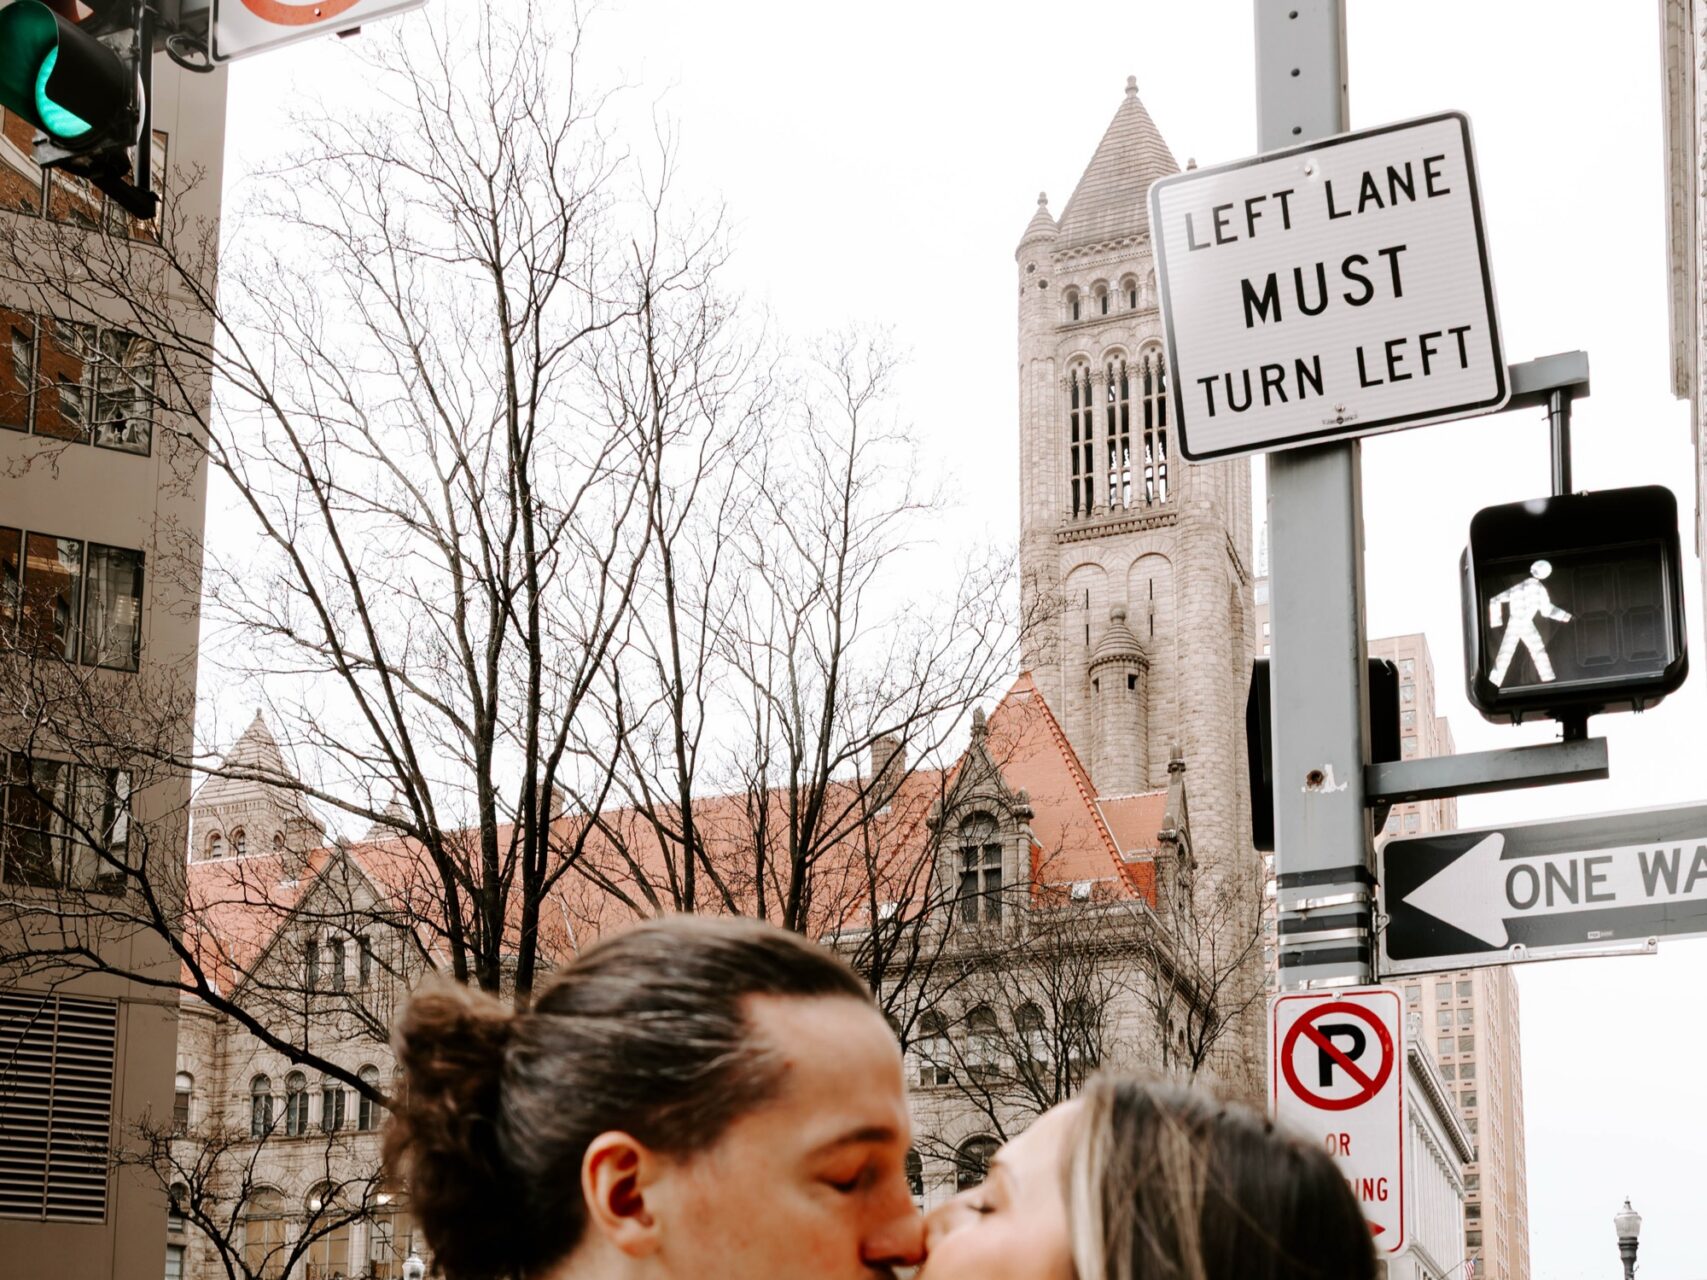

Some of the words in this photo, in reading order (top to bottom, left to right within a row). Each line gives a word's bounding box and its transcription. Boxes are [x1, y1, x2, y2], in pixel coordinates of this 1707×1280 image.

[1185, 188, 1296, 252] LEFT
[1325, 154, 1451, 220] LANE
[1241, 244, 1408, 328] MUST
[1197, 355, 1324, 418] TURN
[1356, 325, 1472, 389] LEFT
[1506, 855, 1616, 911] ONE
[1325, 1132, 1351, 1157] OR
